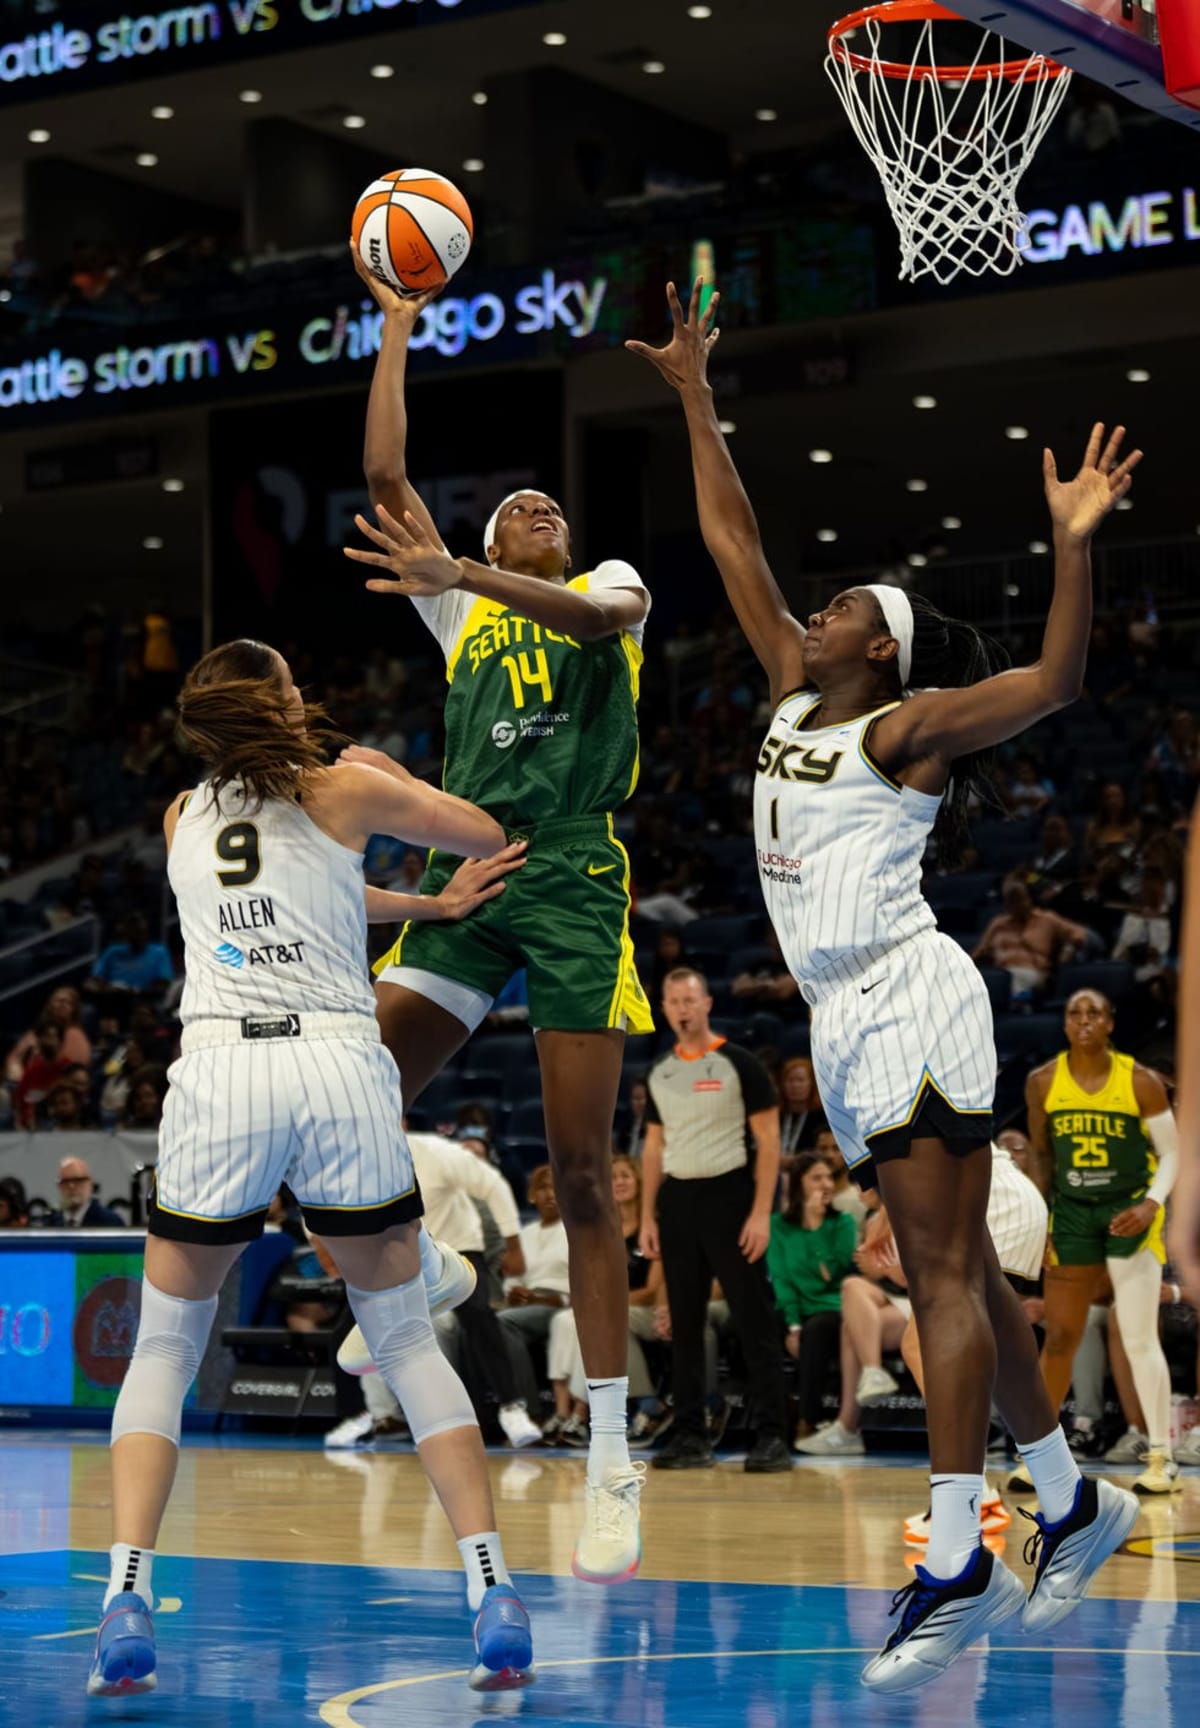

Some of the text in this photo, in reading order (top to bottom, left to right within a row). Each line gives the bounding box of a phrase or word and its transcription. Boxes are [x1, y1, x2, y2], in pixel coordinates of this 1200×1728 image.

[0, 0, 279, 82] attle storm vs
[1016, 190, 1173, 263] GAME
[0, 348, 88, 407] attle
[94, 338, 220, 393] storm
[227, 329, 277, 372] vs
[514, 269, 607, 338] sky
[469, 616, 581, 675] SEATT
[501, 648, 553, 709] 14
[756, 736, 845, 784] SKY
[770, 796, 778, 841] 1
[214, 820, 263, 889] 9
[218, 897, 276, 934] ALLEN
[250, 941, 305, 966] AT&T
[1054, 1113, 1127, 1139] SEATTLE
[1071, 1135, 1109, 1168] 25
